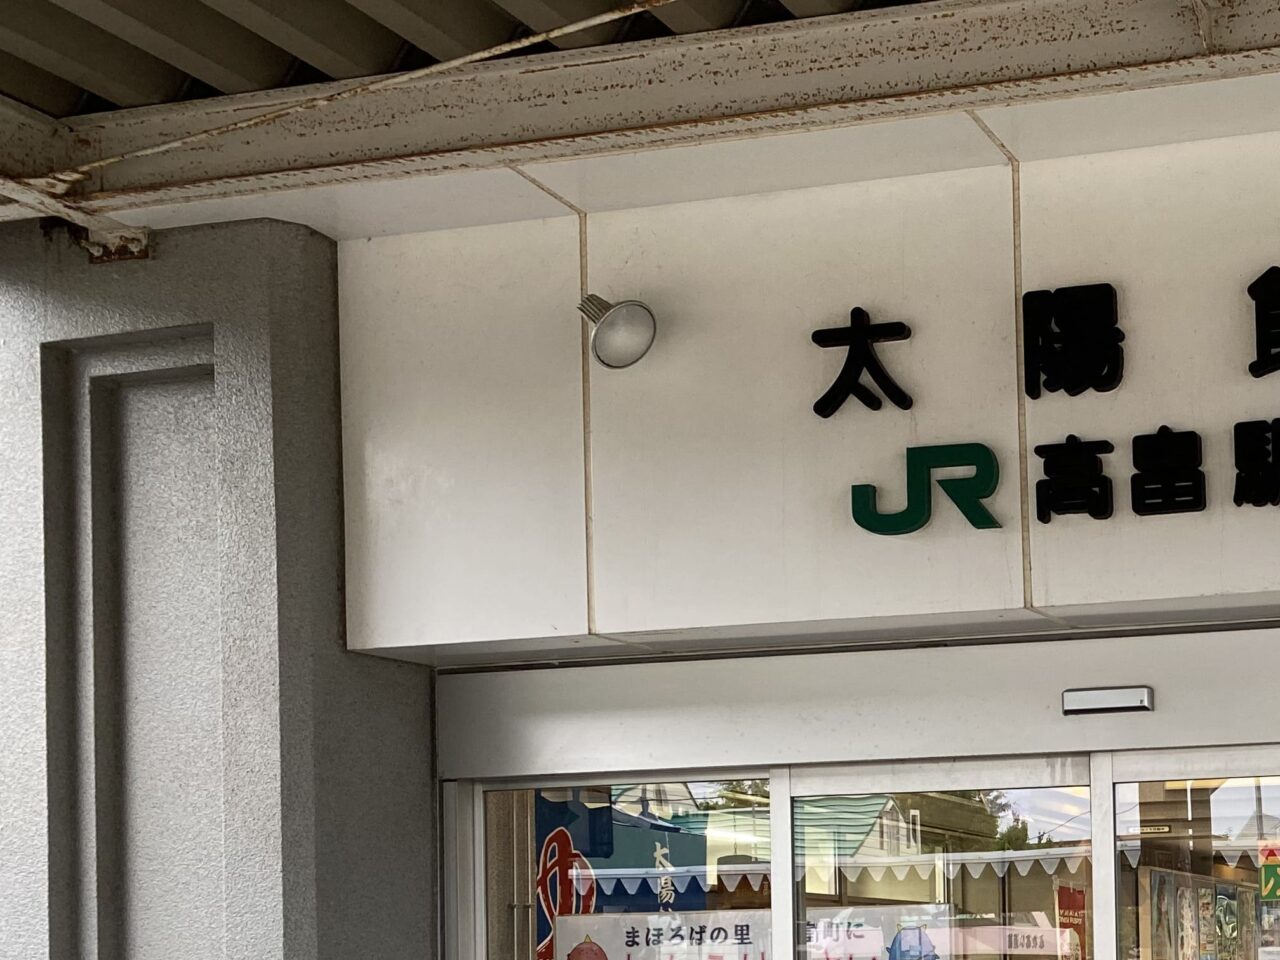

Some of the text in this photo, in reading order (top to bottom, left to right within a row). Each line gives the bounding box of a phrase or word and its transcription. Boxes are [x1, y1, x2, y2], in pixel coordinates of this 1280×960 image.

[624, 922, 753, 948] まほろばの里
